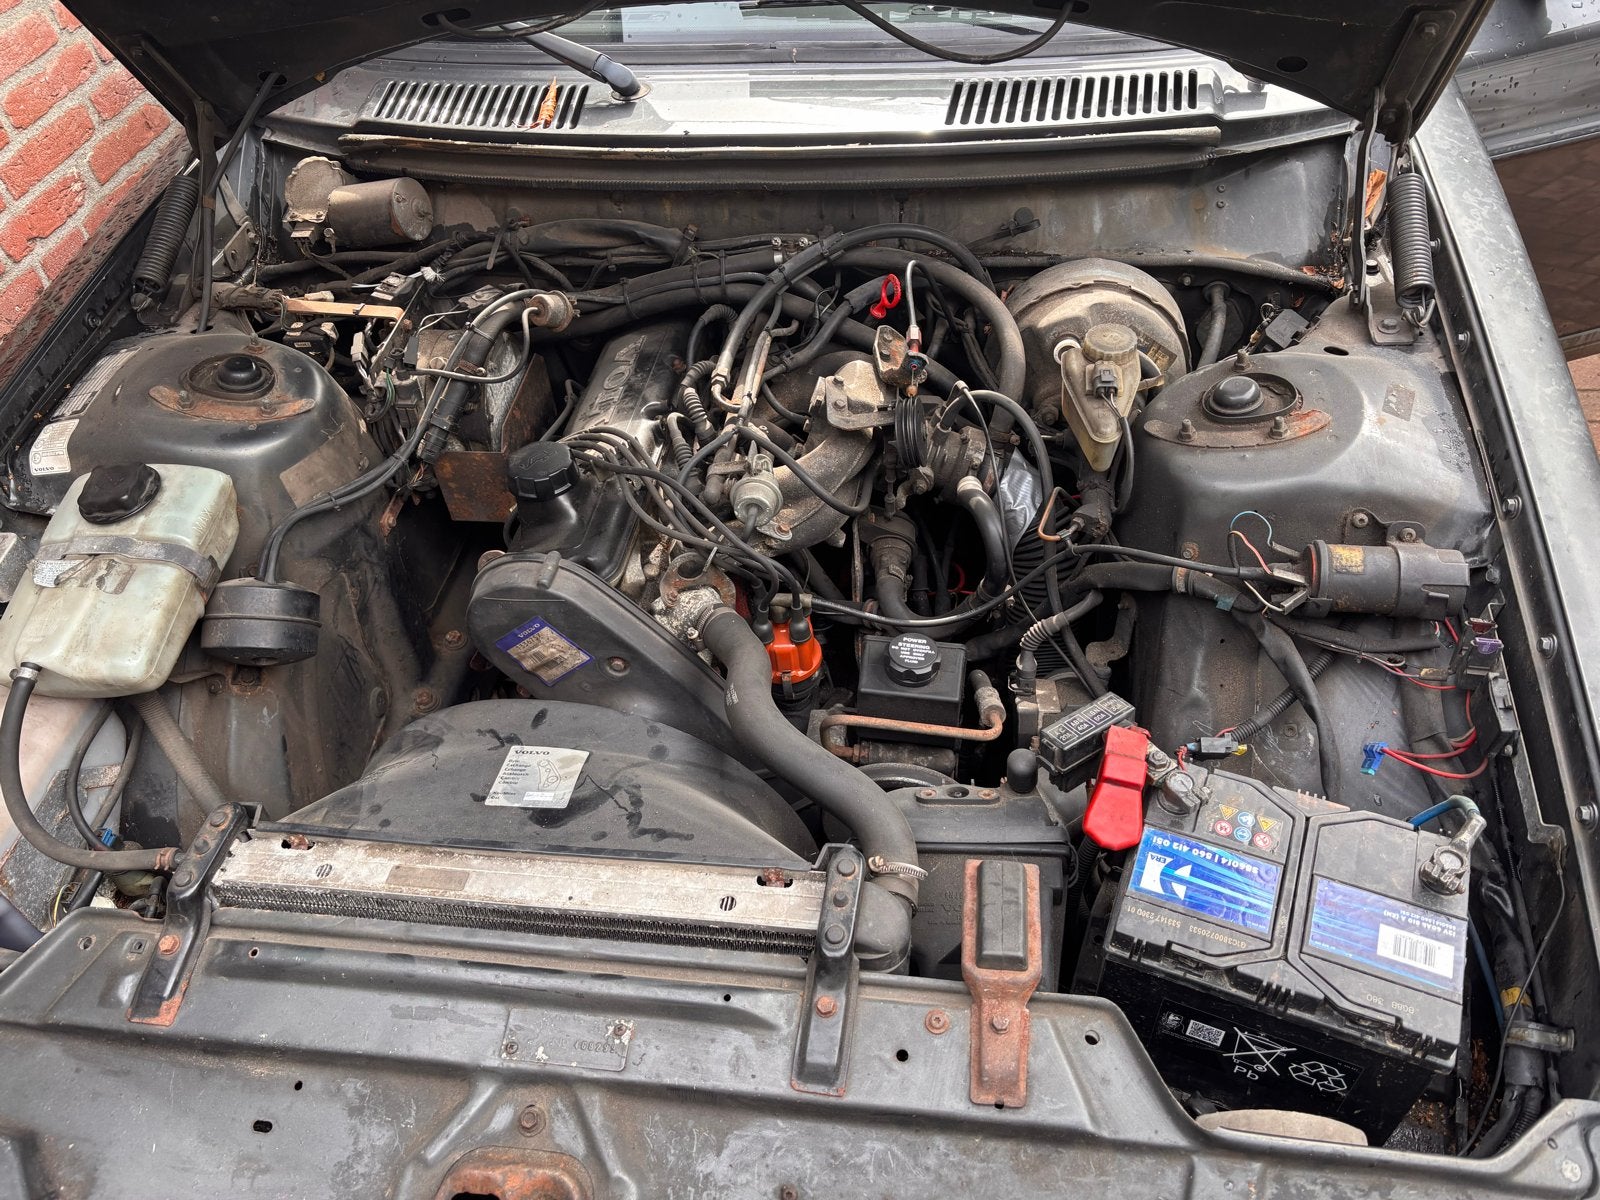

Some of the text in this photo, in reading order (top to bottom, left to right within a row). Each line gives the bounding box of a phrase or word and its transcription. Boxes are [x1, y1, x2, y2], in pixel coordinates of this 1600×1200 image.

[577, 334, 647, 428] VOLV
[518, 623, 540, 638] VOLVO
[1152, 835, 1171, 846] 051
[1172, 841, 1191, 852] 412
[1150, 854, 1167, 864] ERA
[1233, 1065, 1259, 1081] Pb
